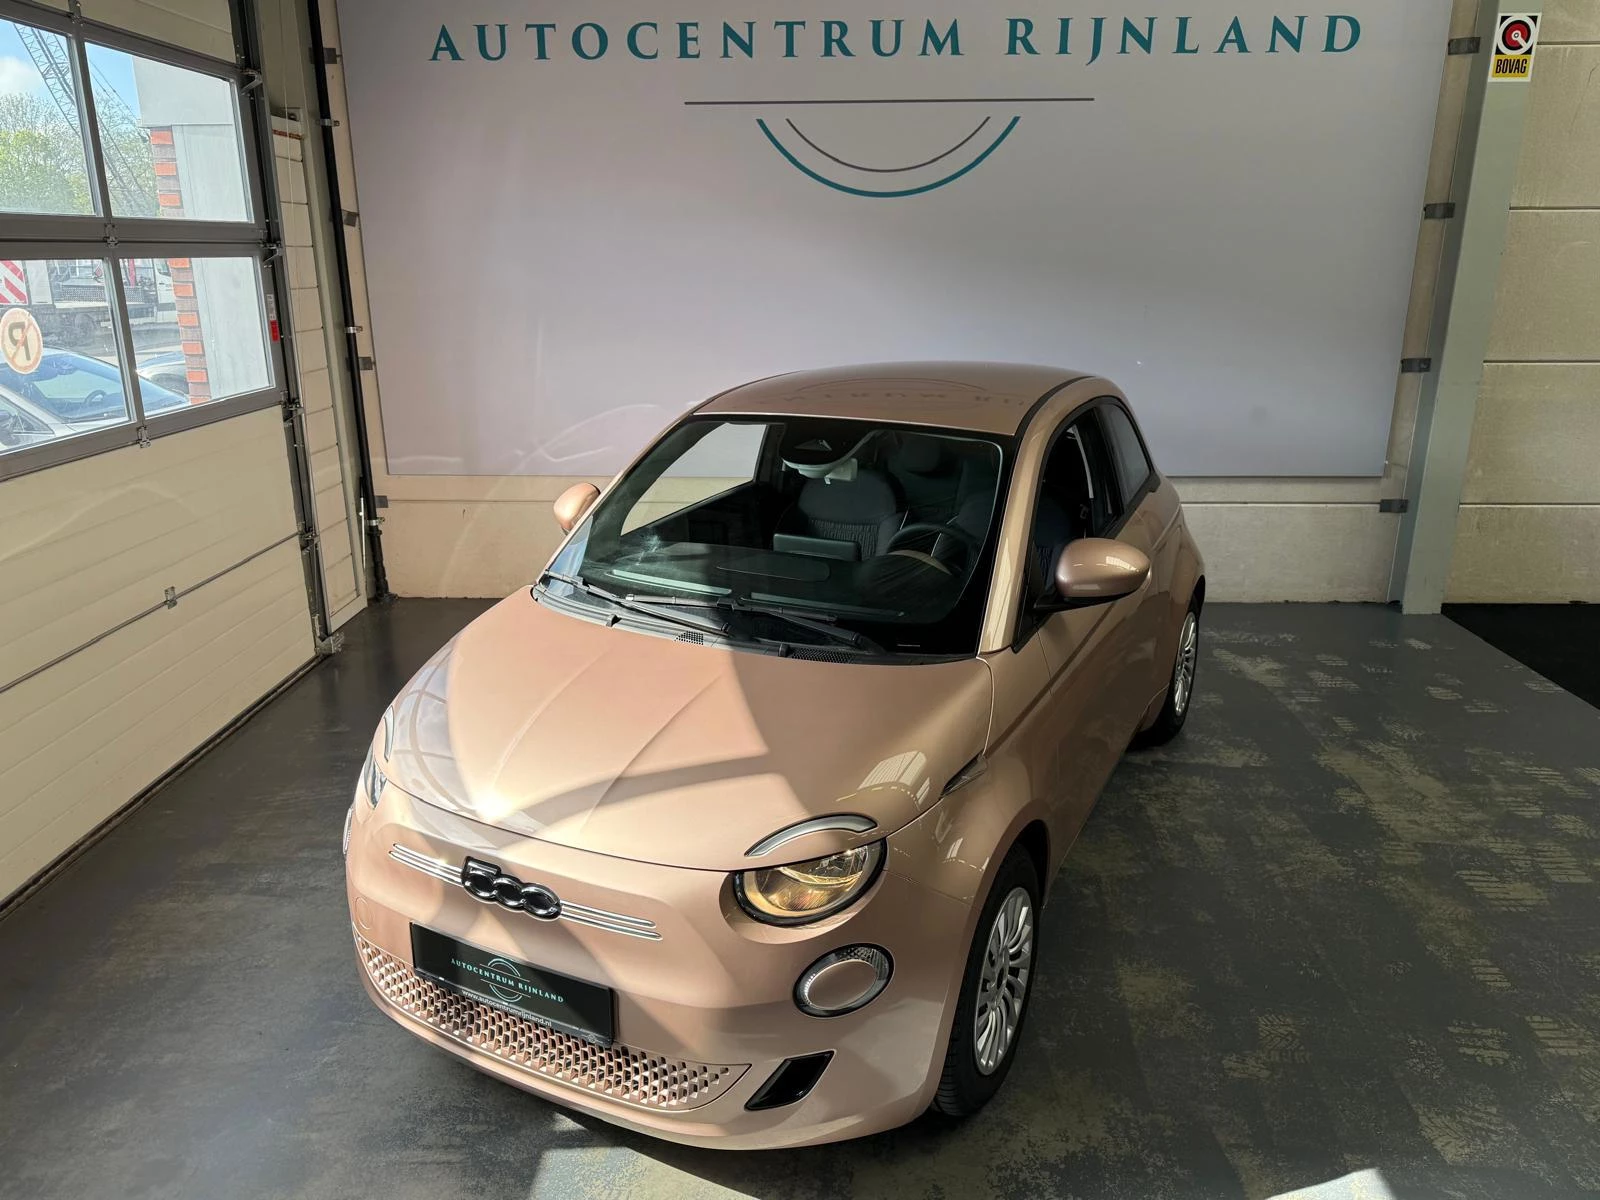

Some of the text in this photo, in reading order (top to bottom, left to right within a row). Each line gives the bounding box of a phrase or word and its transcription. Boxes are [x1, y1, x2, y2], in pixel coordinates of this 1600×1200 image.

[428, 14, 1362, 66] AUTOCENTRUM RIJNLAND
[1495, 58, 1528, 74] BOVAG
[461, 856, 562, 920] 500
[451, 958, 564, 1003] AUTOCENTRUM RIJNLAND
